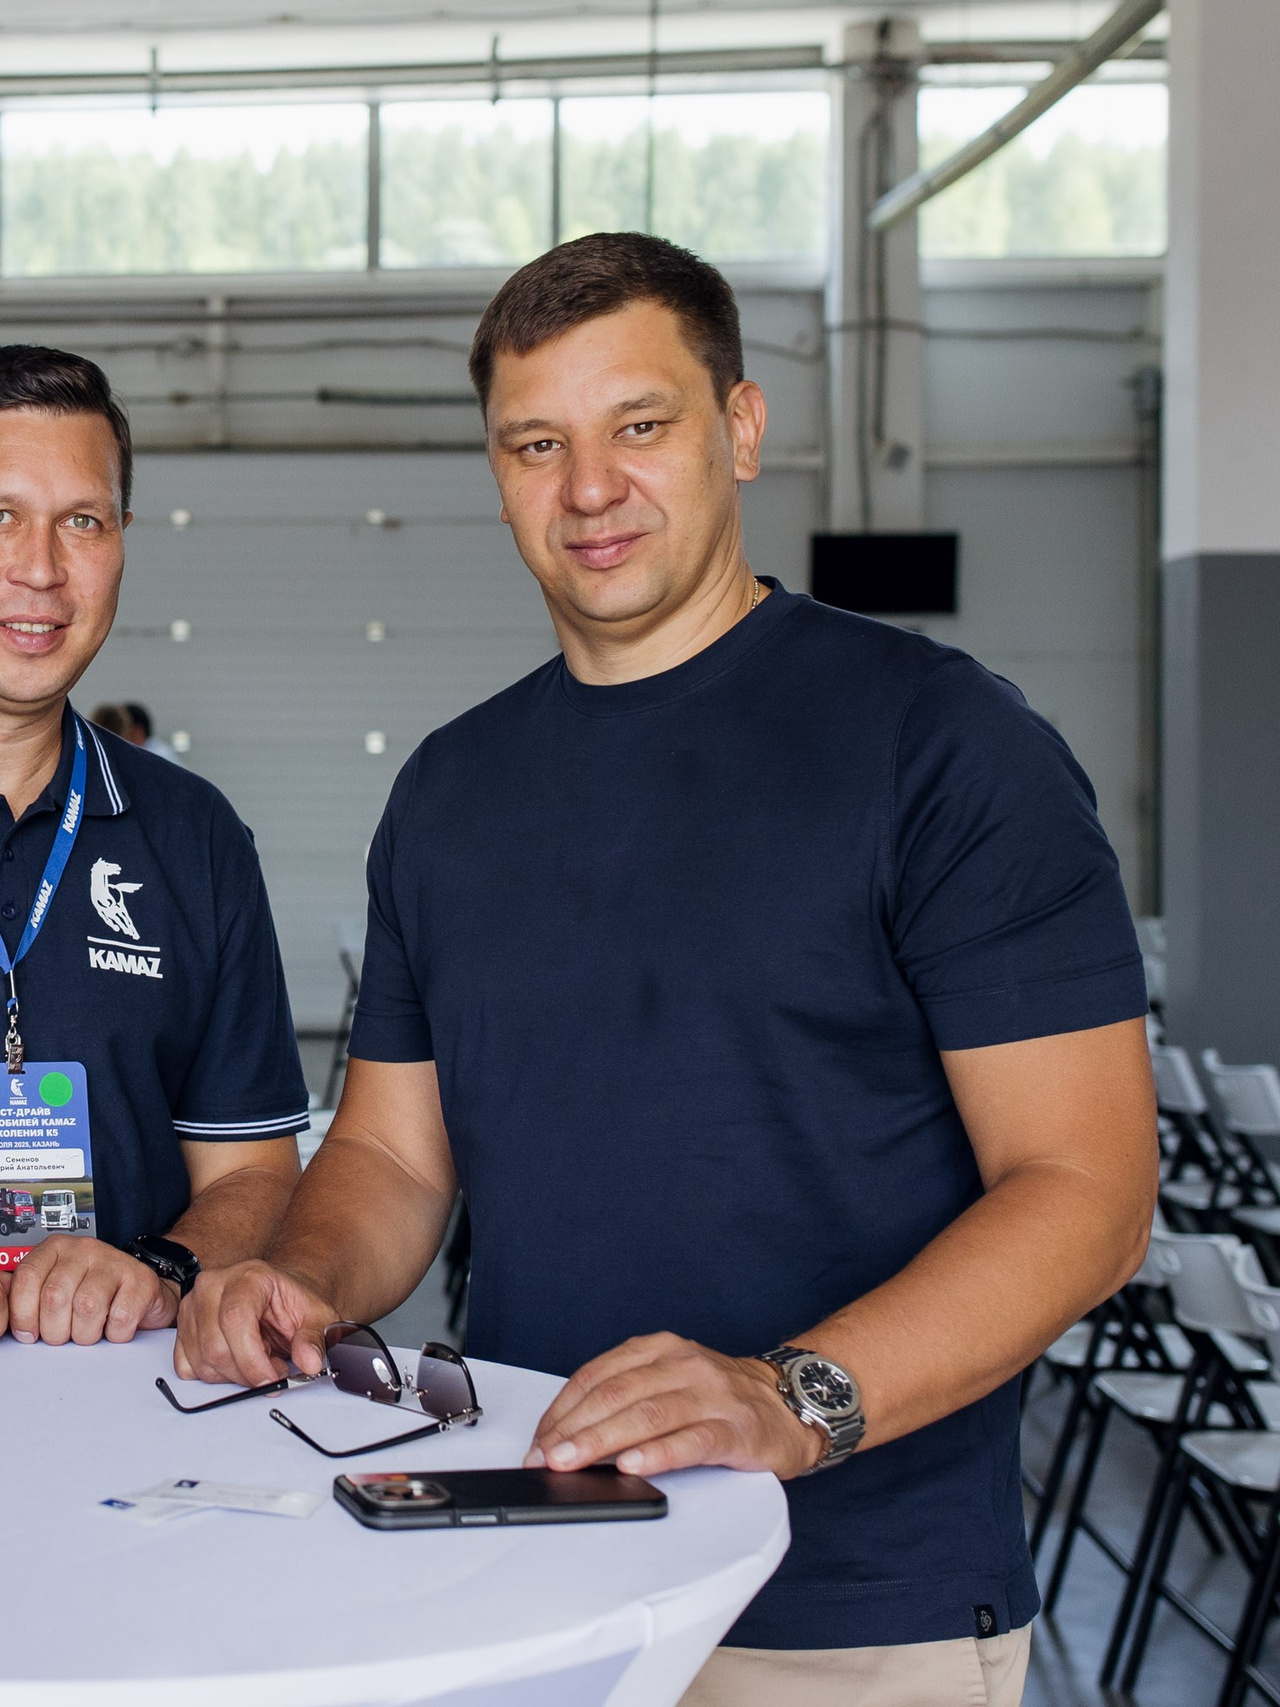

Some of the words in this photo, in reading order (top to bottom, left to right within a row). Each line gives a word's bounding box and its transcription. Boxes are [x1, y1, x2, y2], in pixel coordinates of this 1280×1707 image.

[62, 789, 82, 834] KAMAZ
[30, 879, 54, 929] KAMAZ
[88, 947, 163, 979] KAMAZ
[41, 1118, 76, 1126] KAMAZ
[14, 1141, 32, 1149] 2025,
[5, 1156, 40, 1164] Семенов
